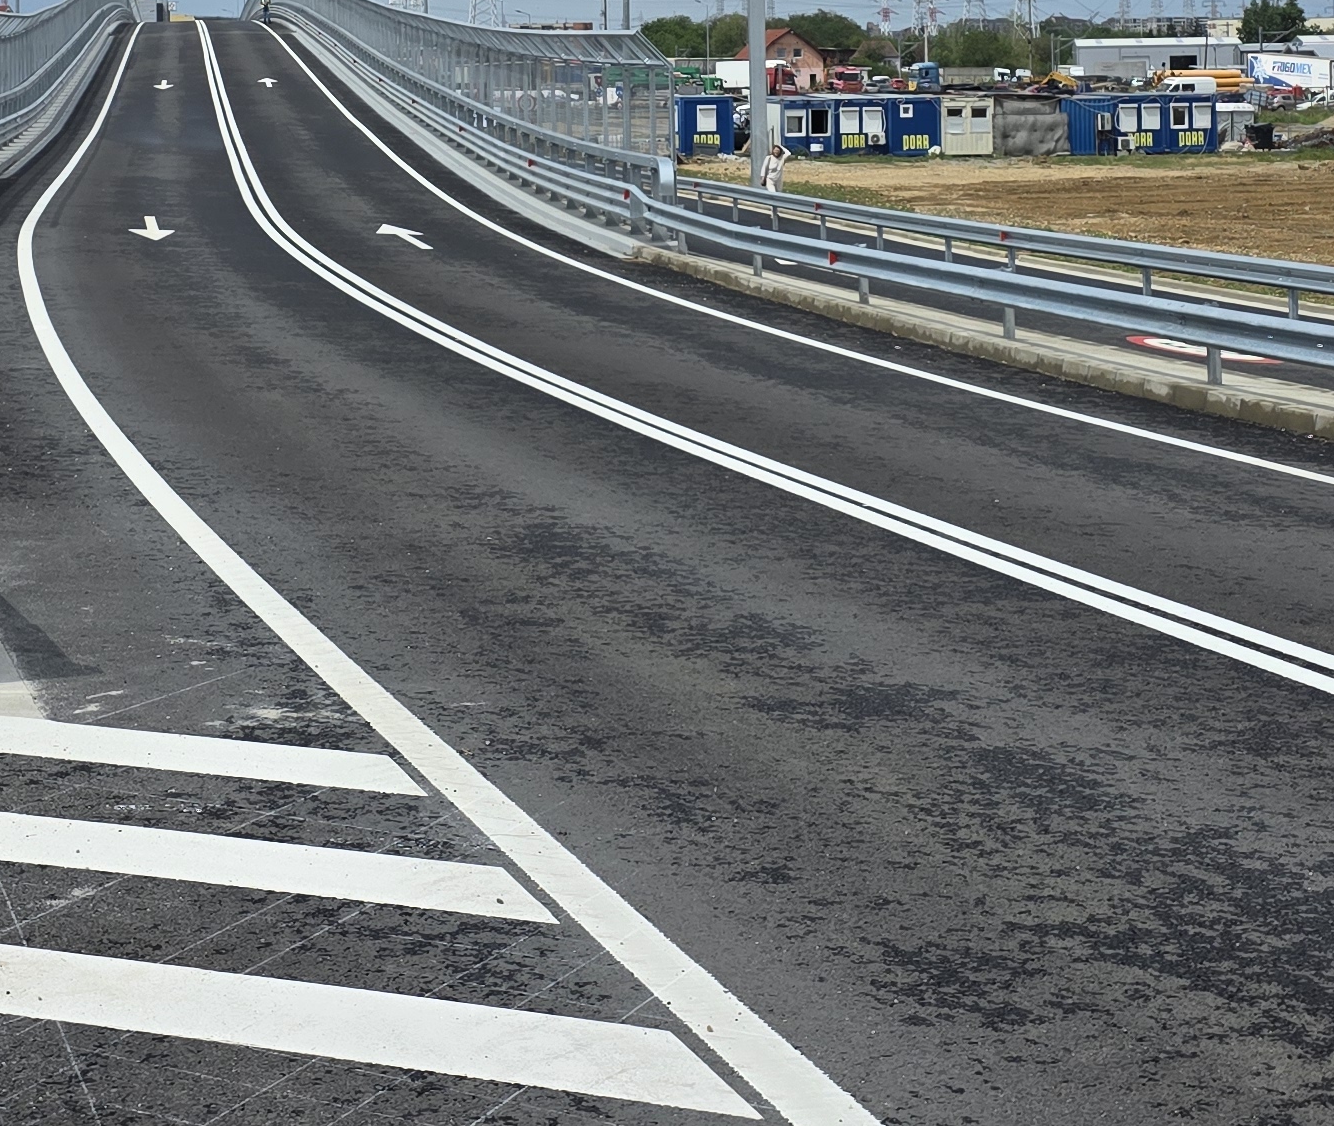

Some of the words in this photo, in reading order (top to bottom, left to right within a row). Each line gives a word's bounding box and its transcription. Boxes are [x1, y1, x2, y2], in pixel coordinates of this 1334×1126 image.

[842, 134, 866, 149] PORR
[903, 134, 930, 151] PORR
[1179, 131, 1204, 147] PORR
